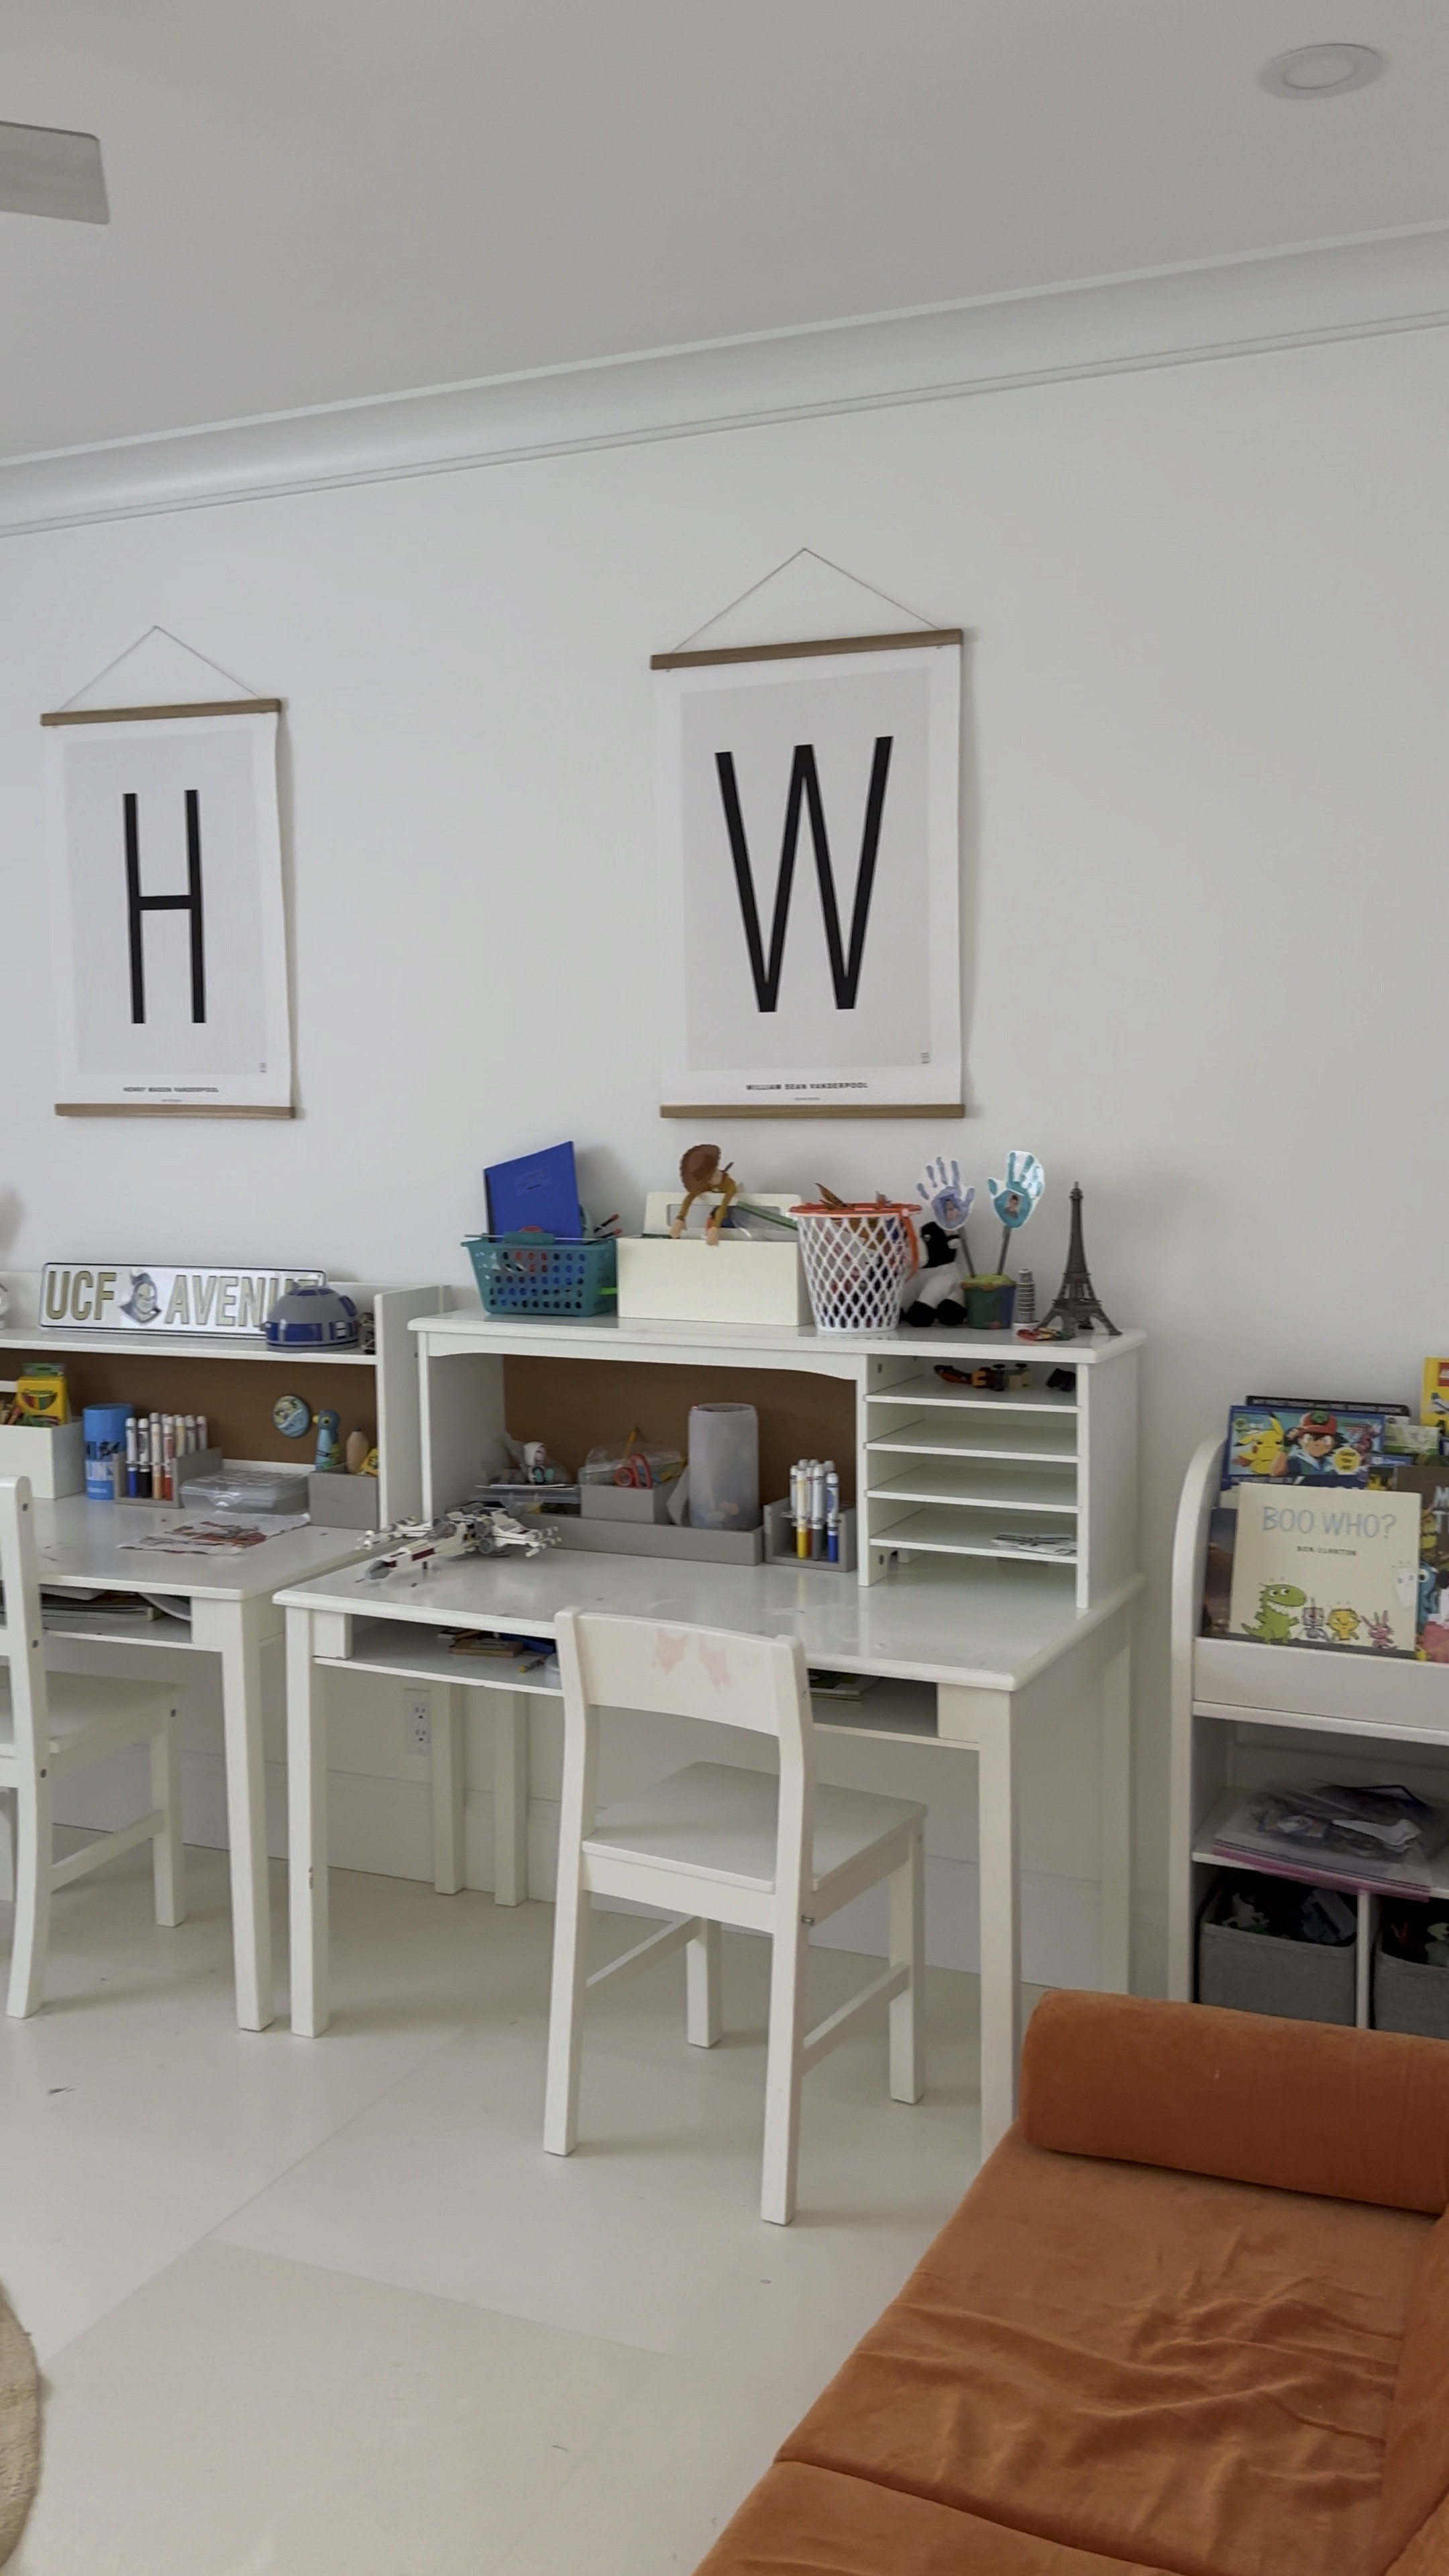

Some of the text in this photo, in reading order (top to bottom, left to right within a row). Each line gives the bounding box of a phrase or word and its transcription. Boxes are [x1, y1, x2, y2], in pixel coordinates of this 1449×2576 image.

[122, 790, 206, 1024] H
[715, 736, 894, 1012] W
[45, 1270, 318, 1328] UCF AVEN
[1258, 1505, 1397, 1539] BOO WHO?
